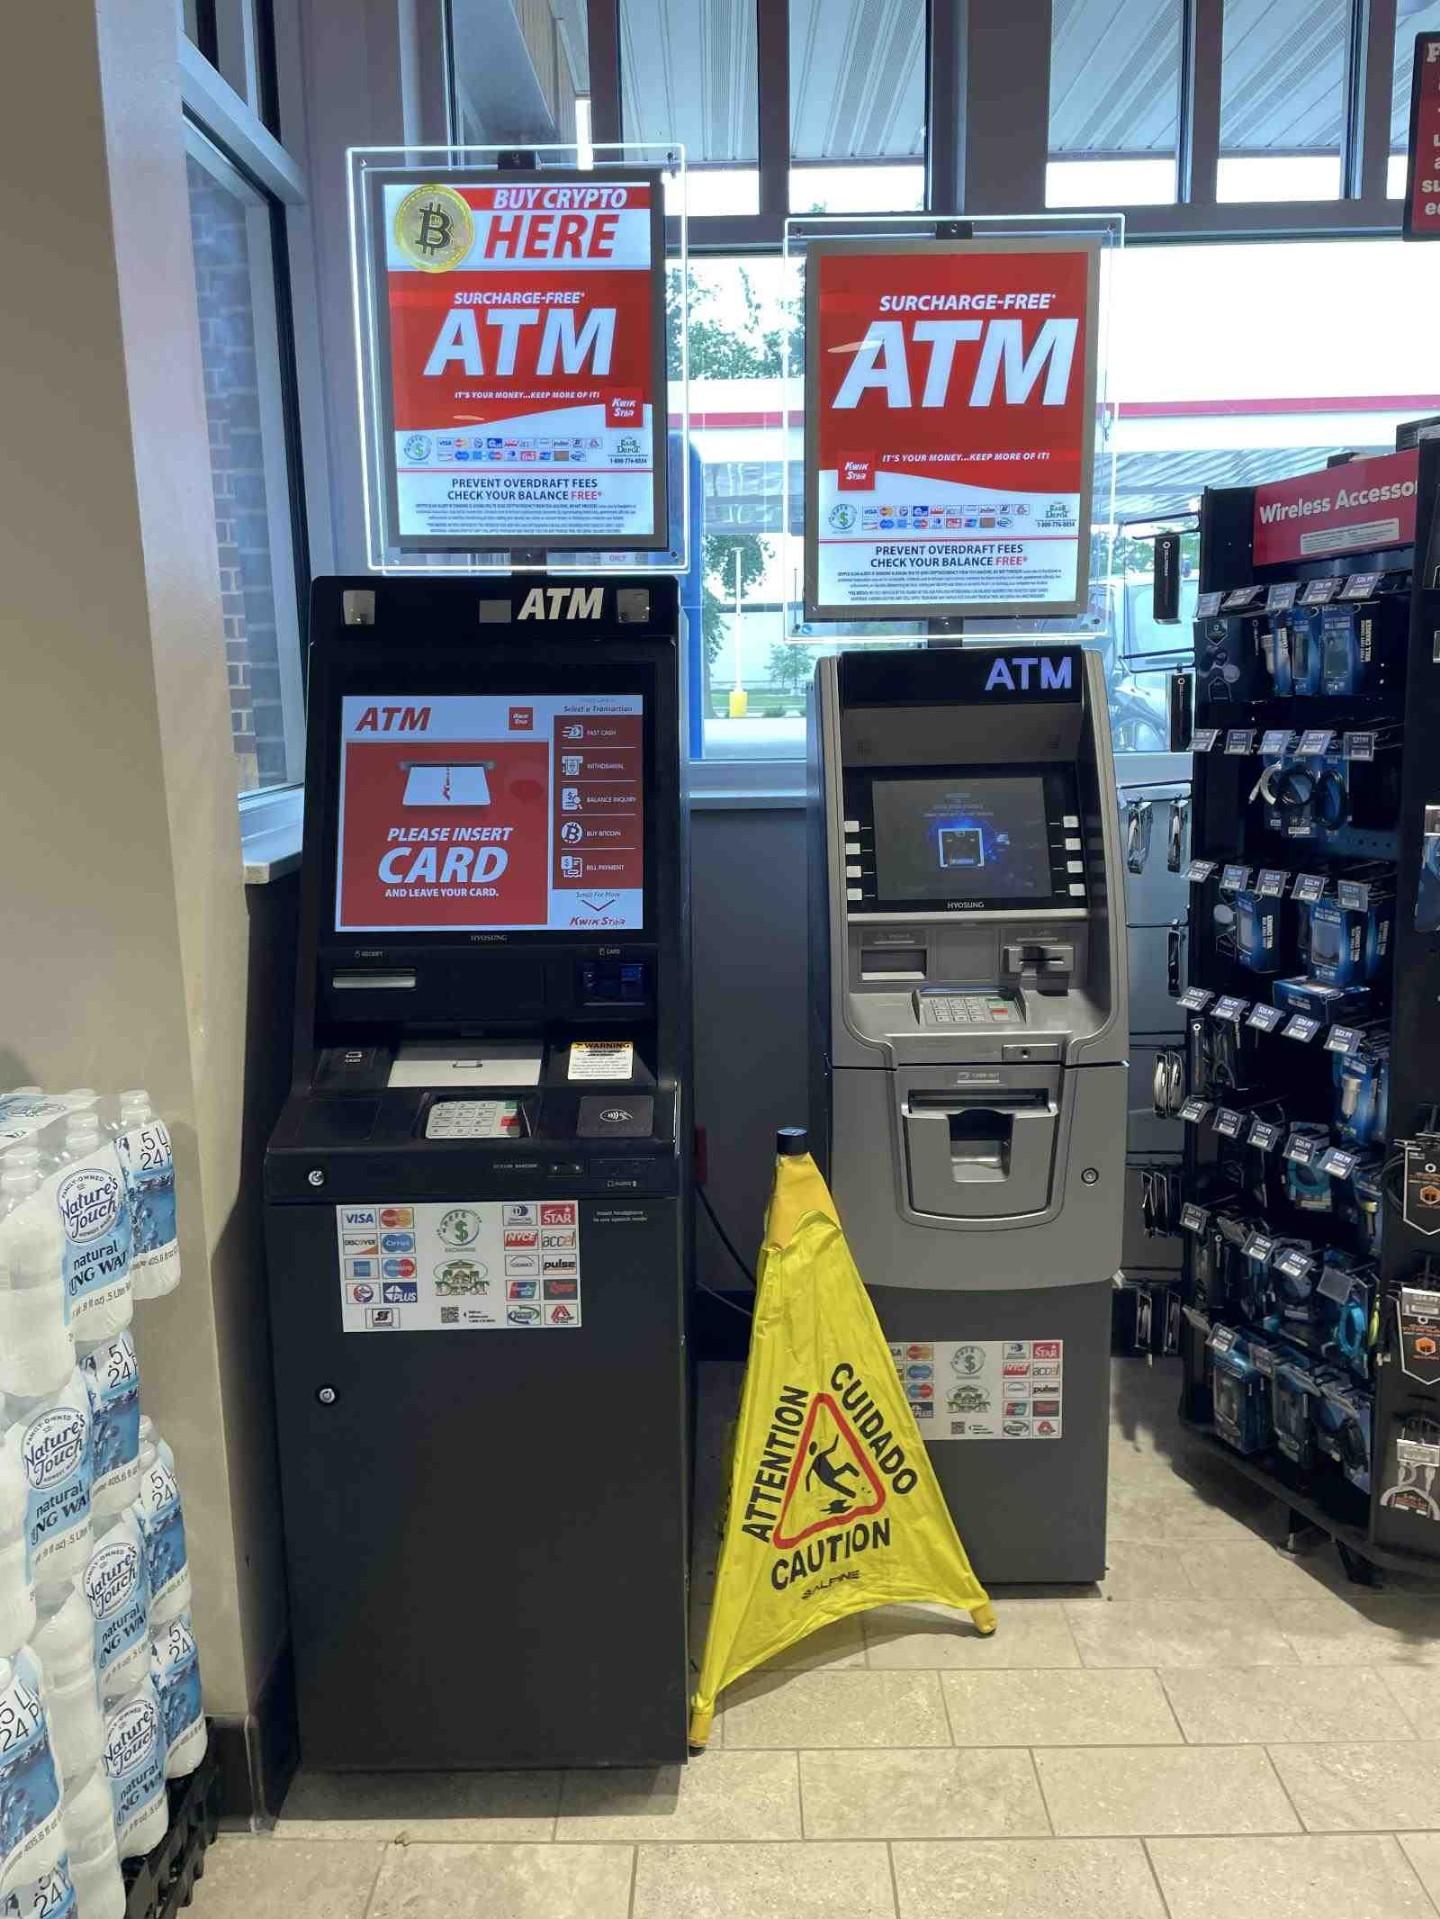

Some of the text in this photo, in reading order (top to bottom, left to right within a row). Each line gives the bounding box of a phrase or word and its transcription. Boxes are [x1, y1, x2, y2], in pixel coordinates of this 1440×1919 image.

[493, 188, 628, 209] BUY CRYPTO
[484, 213, 620, 259] HERE
[423, 308, 617, 376] ATM
[831, 317, 1079, 409] ATM
[454, 391, 471, 399] IT'S
[472, 391, 493, 399] YOUR
[553, 391, 575, 399] MORE
[576, 391, 588, 399] OF
[882, 453, 900, 463] IT'S
[902, 453, 926, 462] YOUR
[994, 452, 1021, 461] MORE
[1023, 452, 1036, 461] OF
[1037, 451, 1050, 460] IT!
[447, 491, 483, 501] CHECK
[486, 491, 516, 500] YOUR
[518, 491, 568, 500] BALANCE
[452, 478, 598, 488] PREVENT OVERDRAFT FEES
[1259, 498, 1331, 525] Wireless
[870, 558, 907, 568] CHECK
[909, 558, 940, 567] YOUR
[942, 557, 993, 567] BALANCE
[875, 544, 1023, 556] PREVENT OVERDRAFT FEES
[516, 587, 605, 620] ATM
[984, 656, 1074, 691] ATM
[355, 707, 431, 732] ATM
[387, 827, 514, 842] PLEASE INSERT
[377, 845, 510, 885] CARD
[385, 886, 499, 898] AND LEAVE YOUR CARD.
[947, 901, 985, 909] HYOSUNG
[140, 1149, 164, 1171] 24
[60, 1176, 118, 1222] Nature's
[69, 1195, 117, 1239] Touch
[346, 1213, 374, 1224] VISA
[543, 1214, 572, 1224] STAR
[507, 1232, 536, 1241] NYCE
[542, 1231, 575, 1247] accel
[73, 1240, 119, 1270] natural
[543, 1259, 576, 1270] pulse
[394, 1292, 416, 1302] PLUS
[1034, 1349, 1058, 1358] STAR
[108, 1364, 132, 1389] 24
[1034, 1384, 1059, 1394] pulse
[24, 1413, 86, 1467] Nature's
[831, 1362, 918, 1495] CUIDADO
[34, 1437, 83, 1486] Touch
[741, 1385, 809, 1543] ATTENTION
[36, 1480, 82, 1519] natural
[152, 1484, 174, 1511] 24
[771, 1517, 891, 1591] CAUTION
[87, 1546, 137, 1601] Nature's
[96, 1565, 136, 1618] Touch
[102, 1602, 140, 1643] natural
[168, 1637, 192, 1664] 24
[0, 1717, 30, 1752] 24
[104, 1702, 155, 1764] Nature's
[120, 1760, 159, 1801] natural
[34, 1882, 63, 1919] 24
